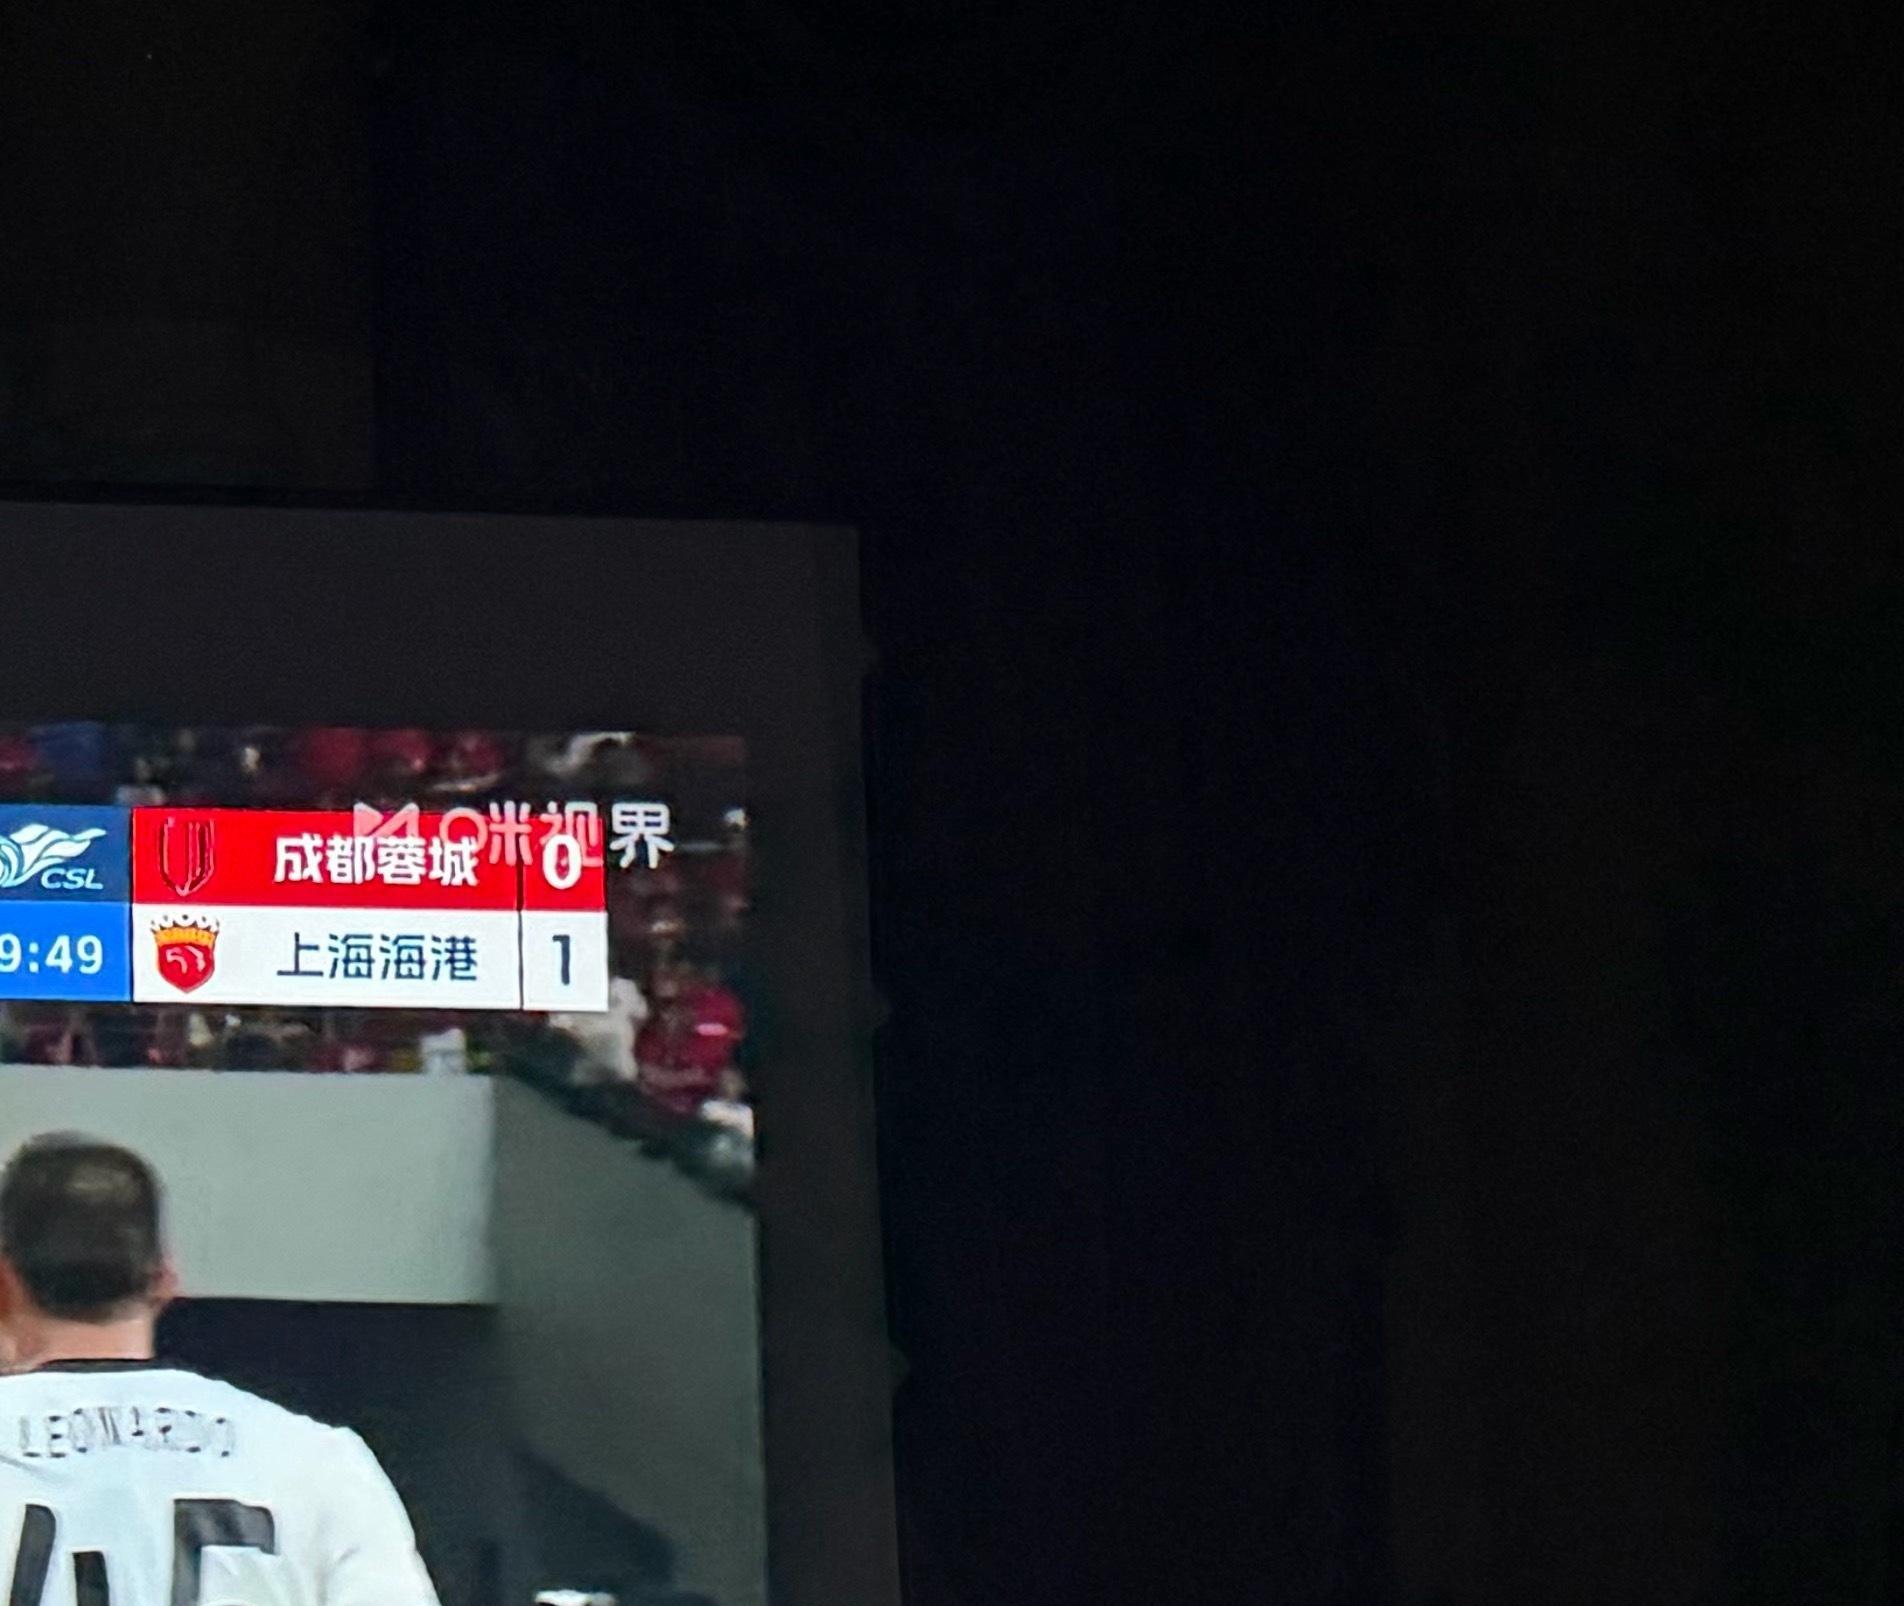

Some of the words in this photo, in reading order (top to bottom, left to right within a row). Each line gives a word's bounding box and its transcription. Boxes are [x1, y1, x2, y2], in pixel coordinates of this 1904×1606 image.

[41, 867, 104, 890] CSL
[273, 832, 479, 887] 成都蓉城
[542, 833, 582, 890] 0
[276, 932, 477, 982] 上海海港
[552, 934, 572, 986] 1
[19, 1405, 236, 1459] LEONARDO
